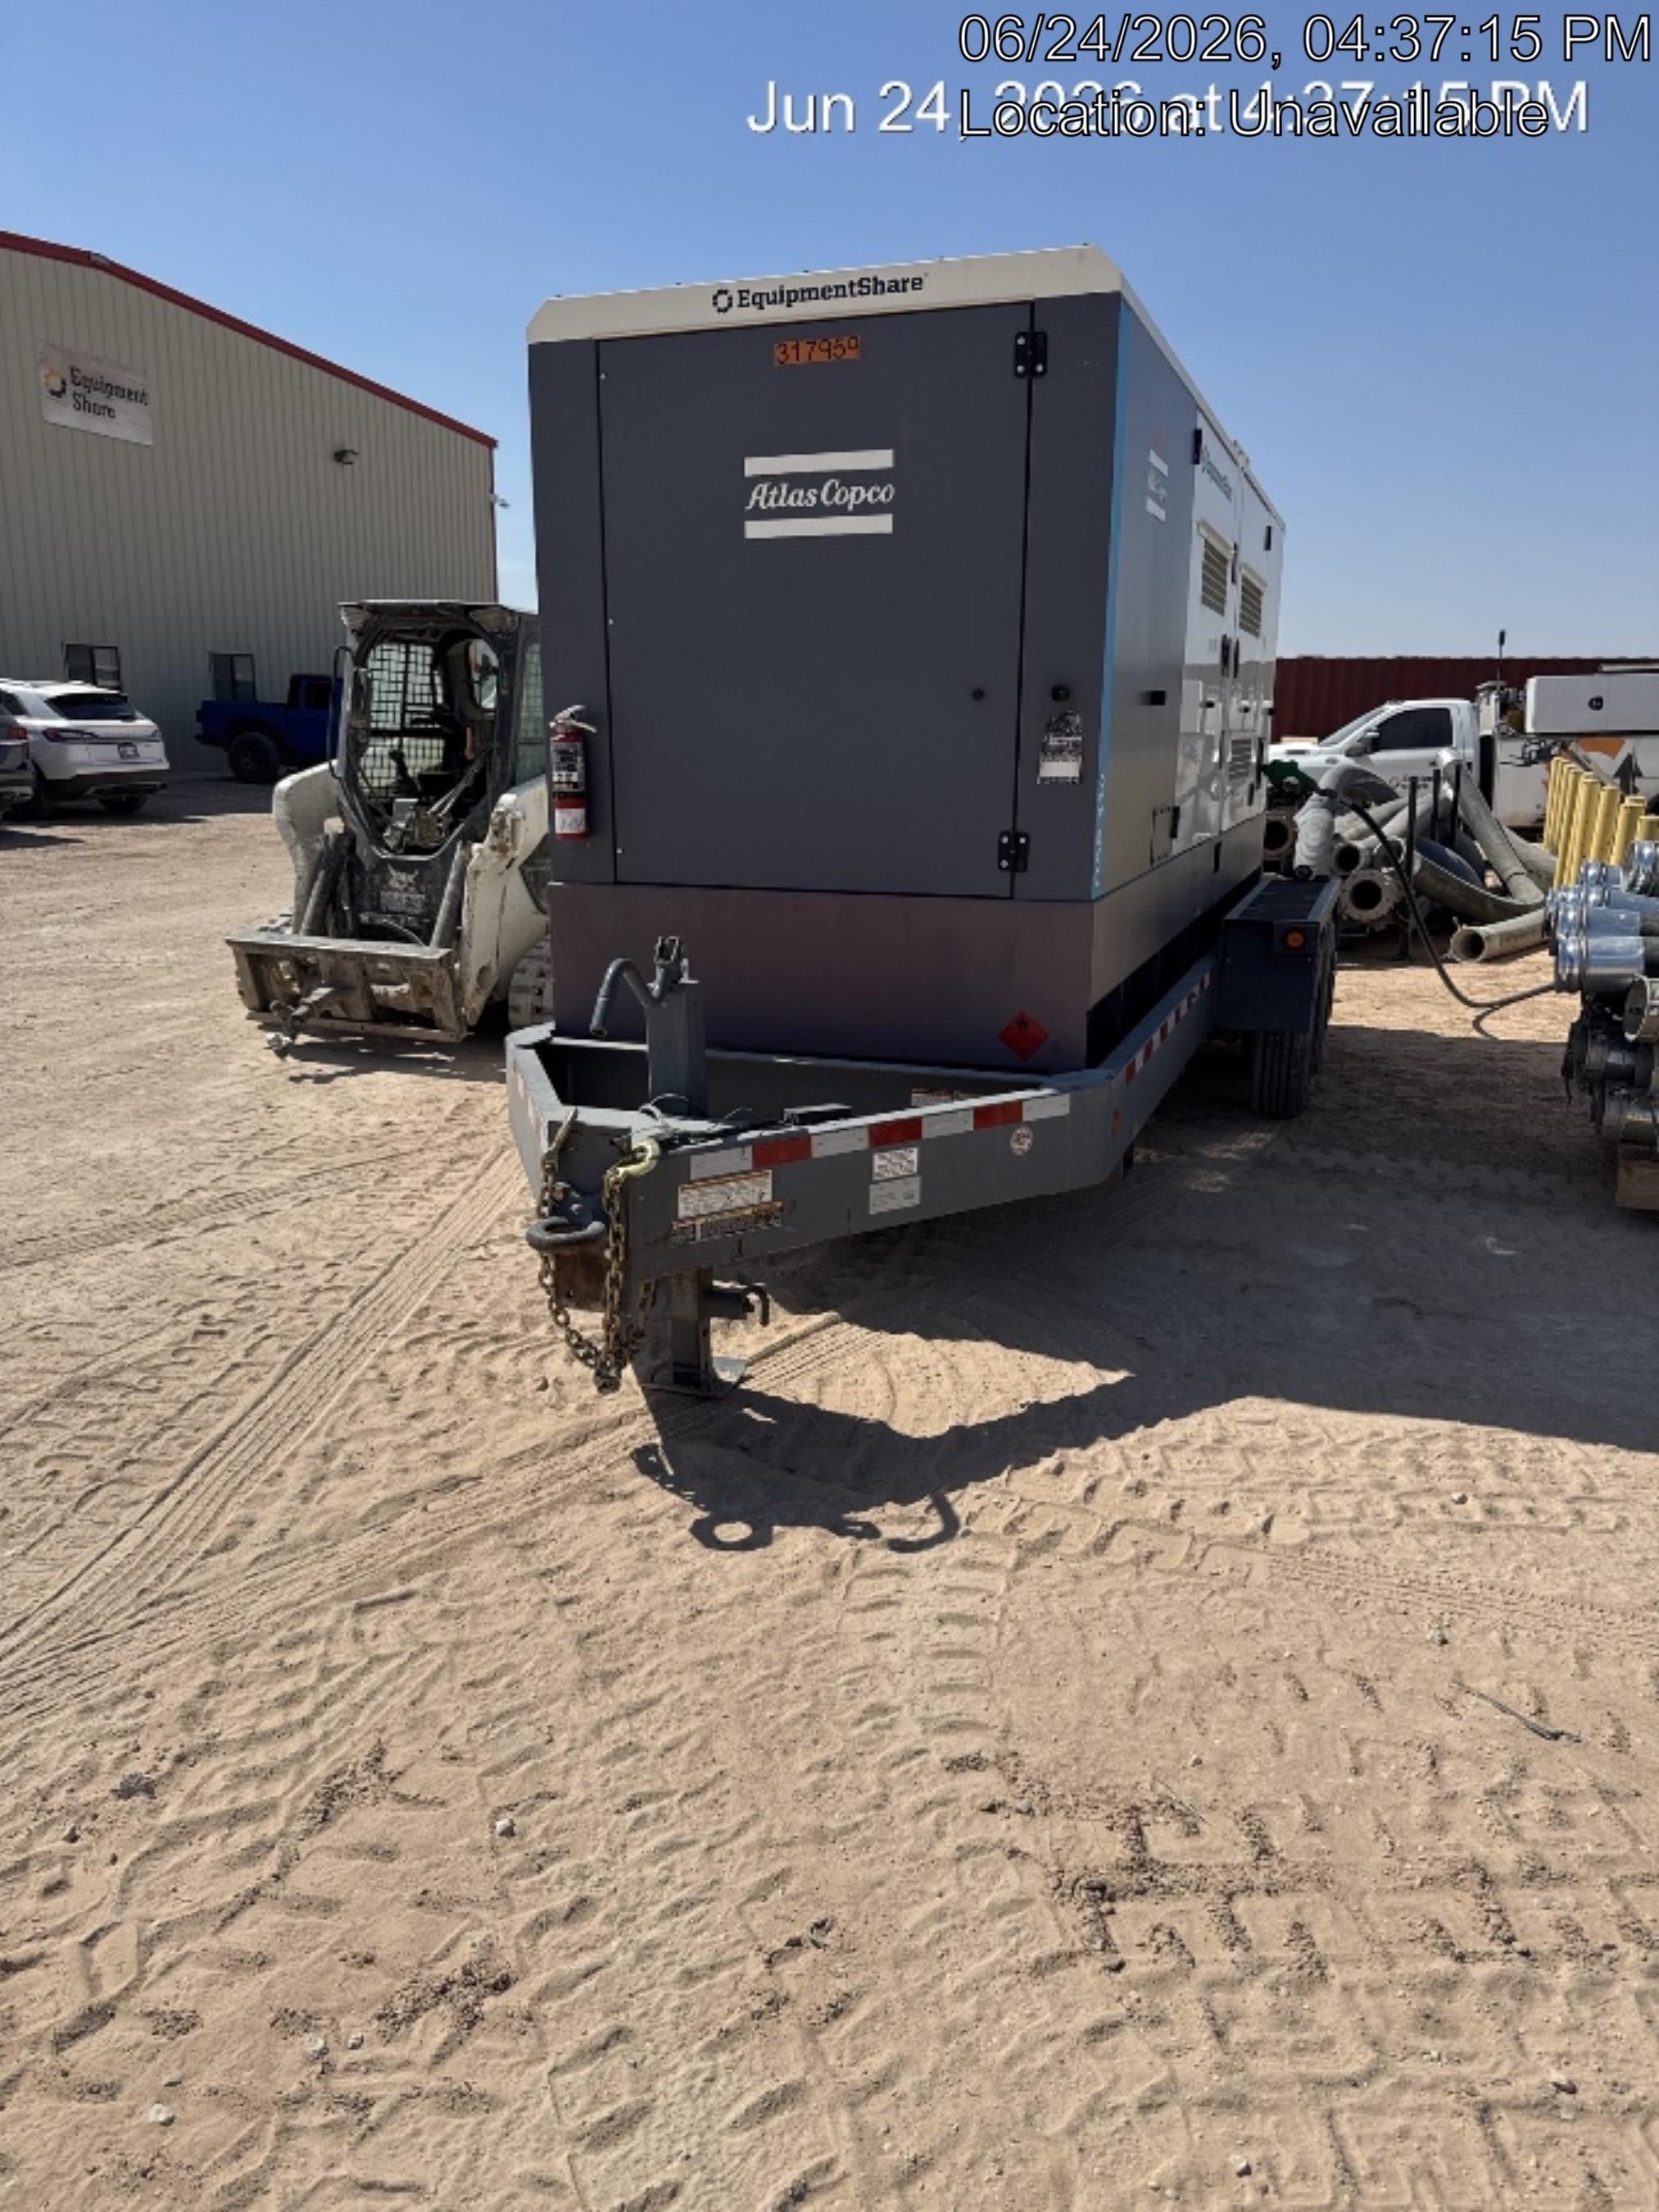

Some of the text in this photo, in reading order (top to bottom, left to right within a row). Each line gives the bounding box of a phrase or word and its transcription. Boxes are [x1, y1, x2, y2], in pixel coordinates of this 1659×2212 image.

[737, 276, 923, 310] EquipmentShare
[69, 365, 148, 407] Equipment
[72, 391, 116, 419] Share
[745, 478, 895, 511] Atlas Copco
